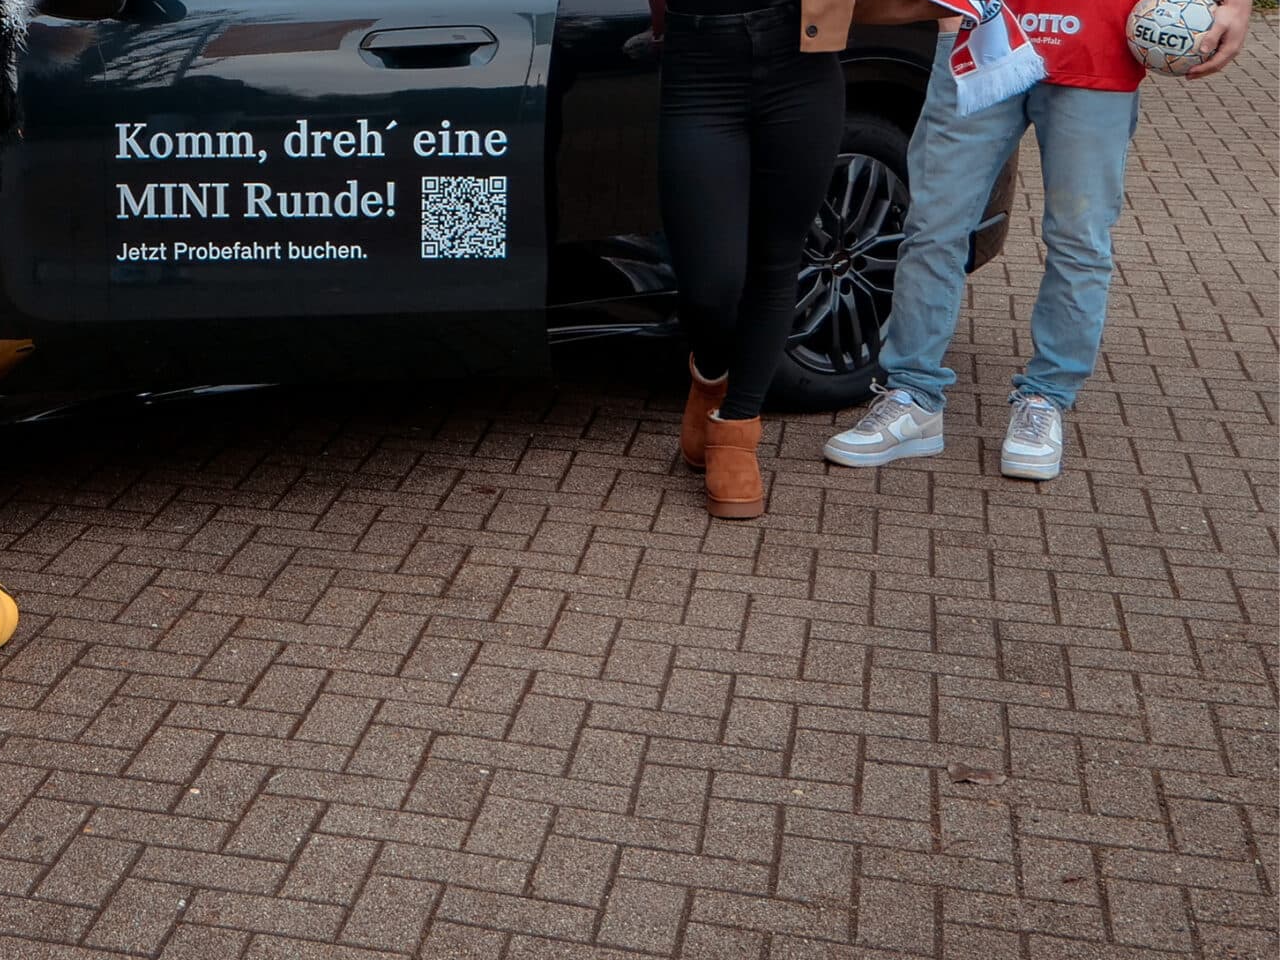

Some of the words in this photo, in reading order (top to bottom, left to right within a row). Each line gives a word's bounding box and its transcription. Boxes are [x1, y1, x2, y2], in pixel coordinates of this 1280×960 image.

[1016, 12, 1081, 35] OTTO
[1135, 24, 1189, 50] SELECT
[115, 122, 269, 164] Komm,
[412, 119, 508, 157] eine
[116, 182, 230, 219] MINI
[243, 179, 397, 218] Runde!
[116, 242, 167, 261] Jetzt
[173, 241, 282, 261] Probefahrt
[288, 241, 368, 261] buchen.
